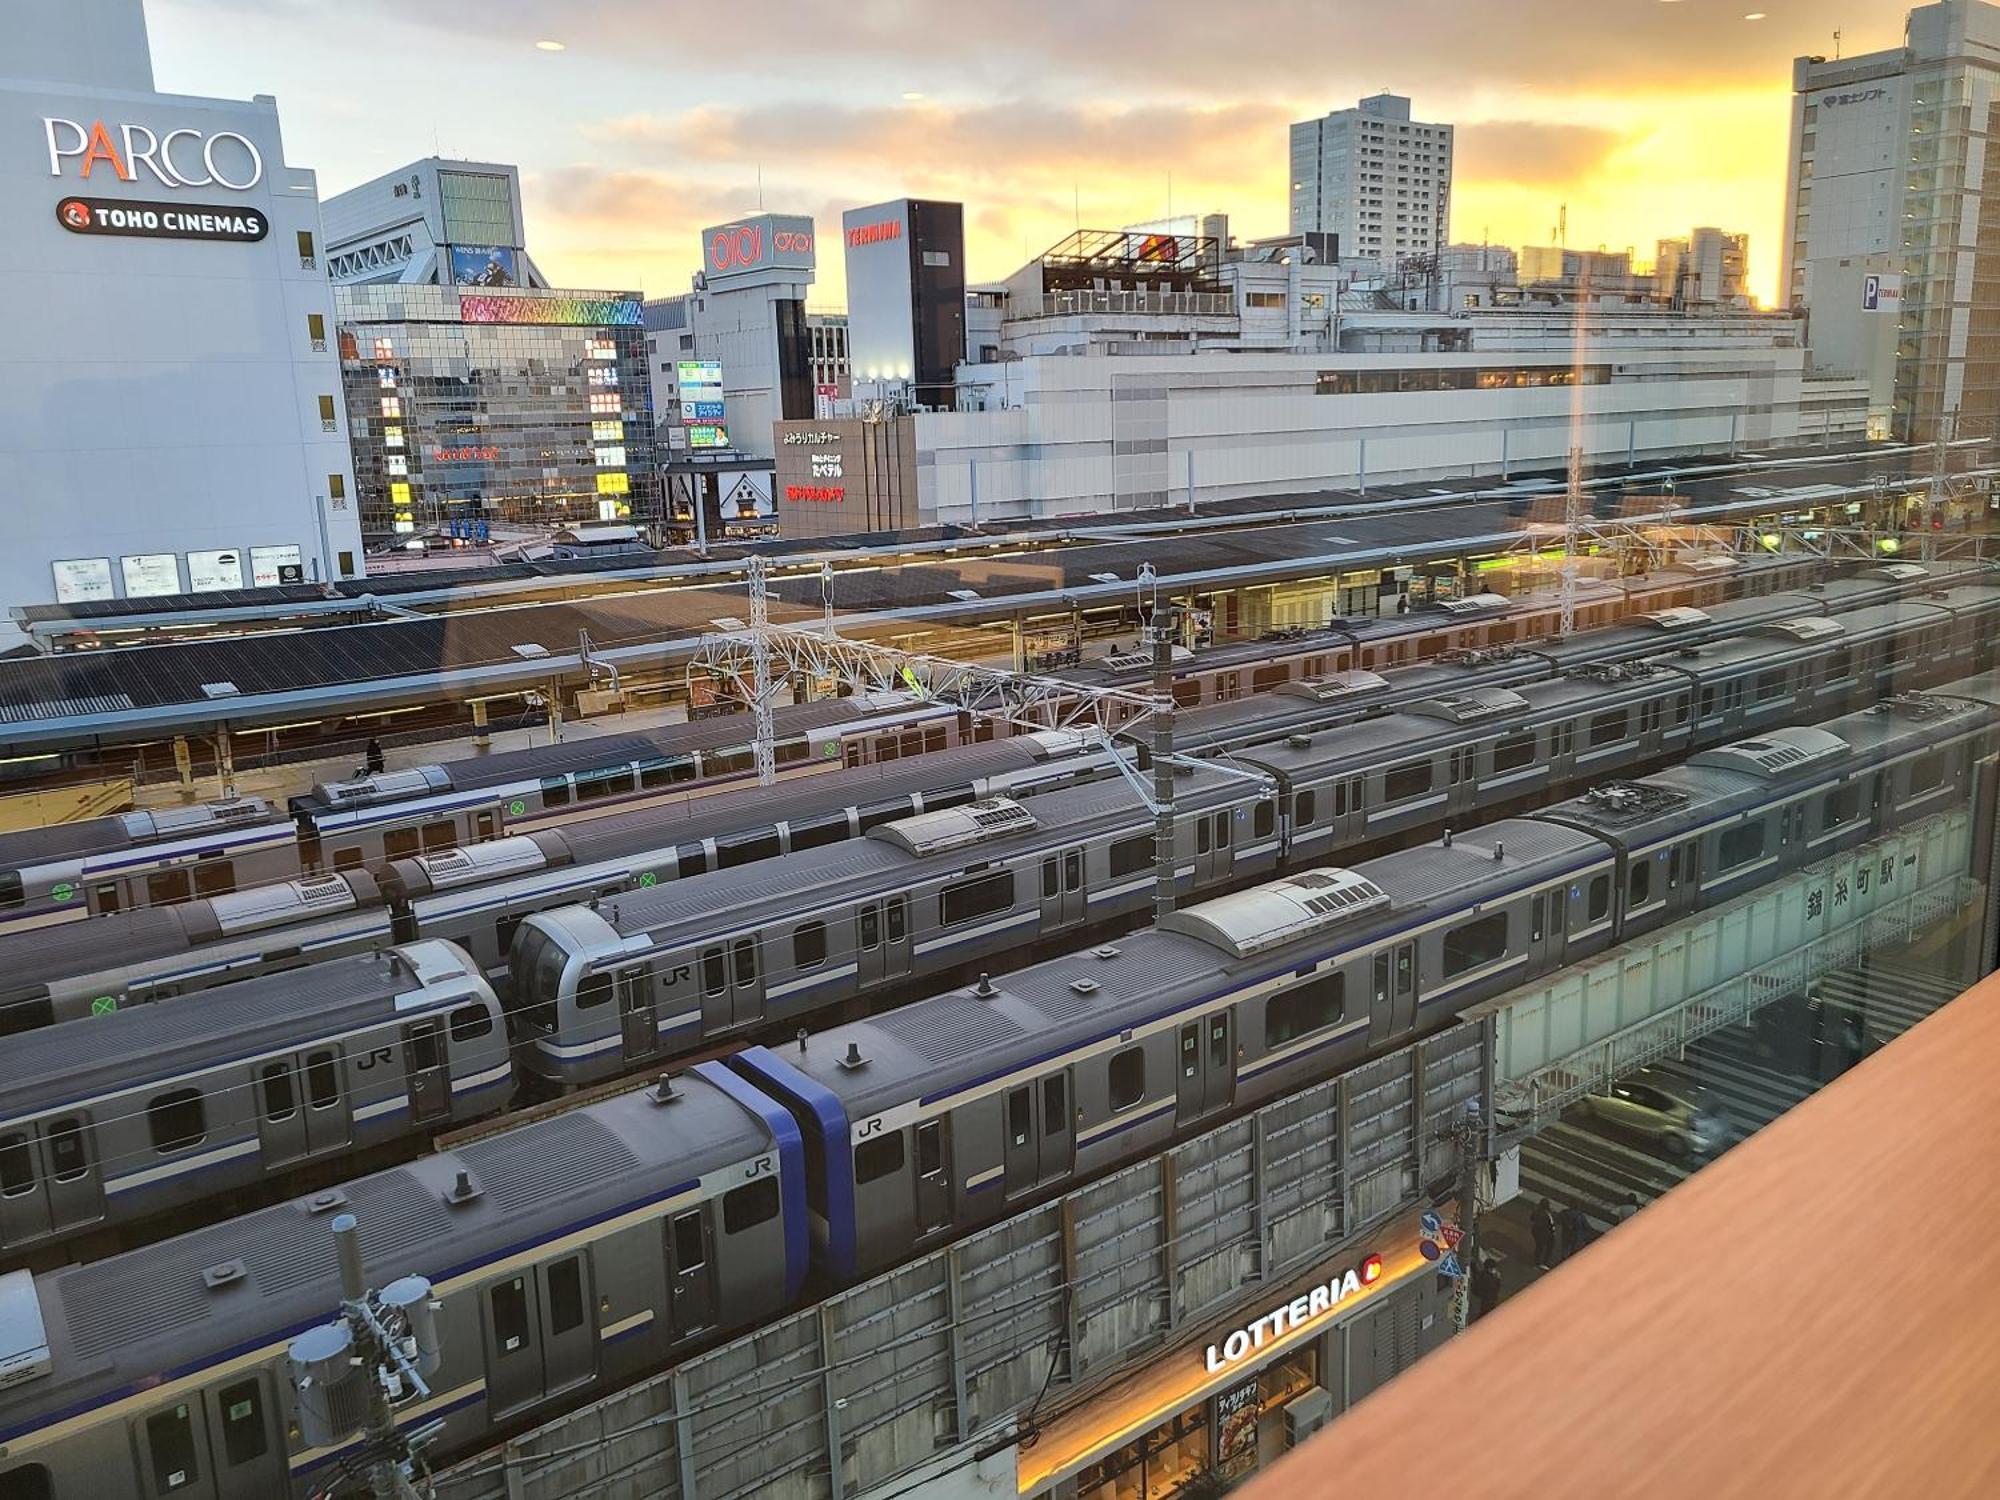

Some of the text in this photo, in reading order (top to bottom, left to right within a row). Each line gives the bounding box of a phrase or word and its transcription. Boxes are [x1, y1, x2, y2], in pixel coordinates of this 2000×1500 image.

[43, 117, 263, 191] PARCO
[95, 208, 260, 235] TOHO CINEMAS
[1865, 278, 1877, 307] P
[783, 431, 841, 445] よみうりカルチャー
[1806, 856, 1894, 921] 錦糸町駅
[663, 966, 690, 987] JR
[357, 1047, 394, 1070] JR
[858, 1118, 883, 1138] JR
[745, 1157, 771, 1178] JR
[1205, 1268, 1360, 1374] LOTTERIA
